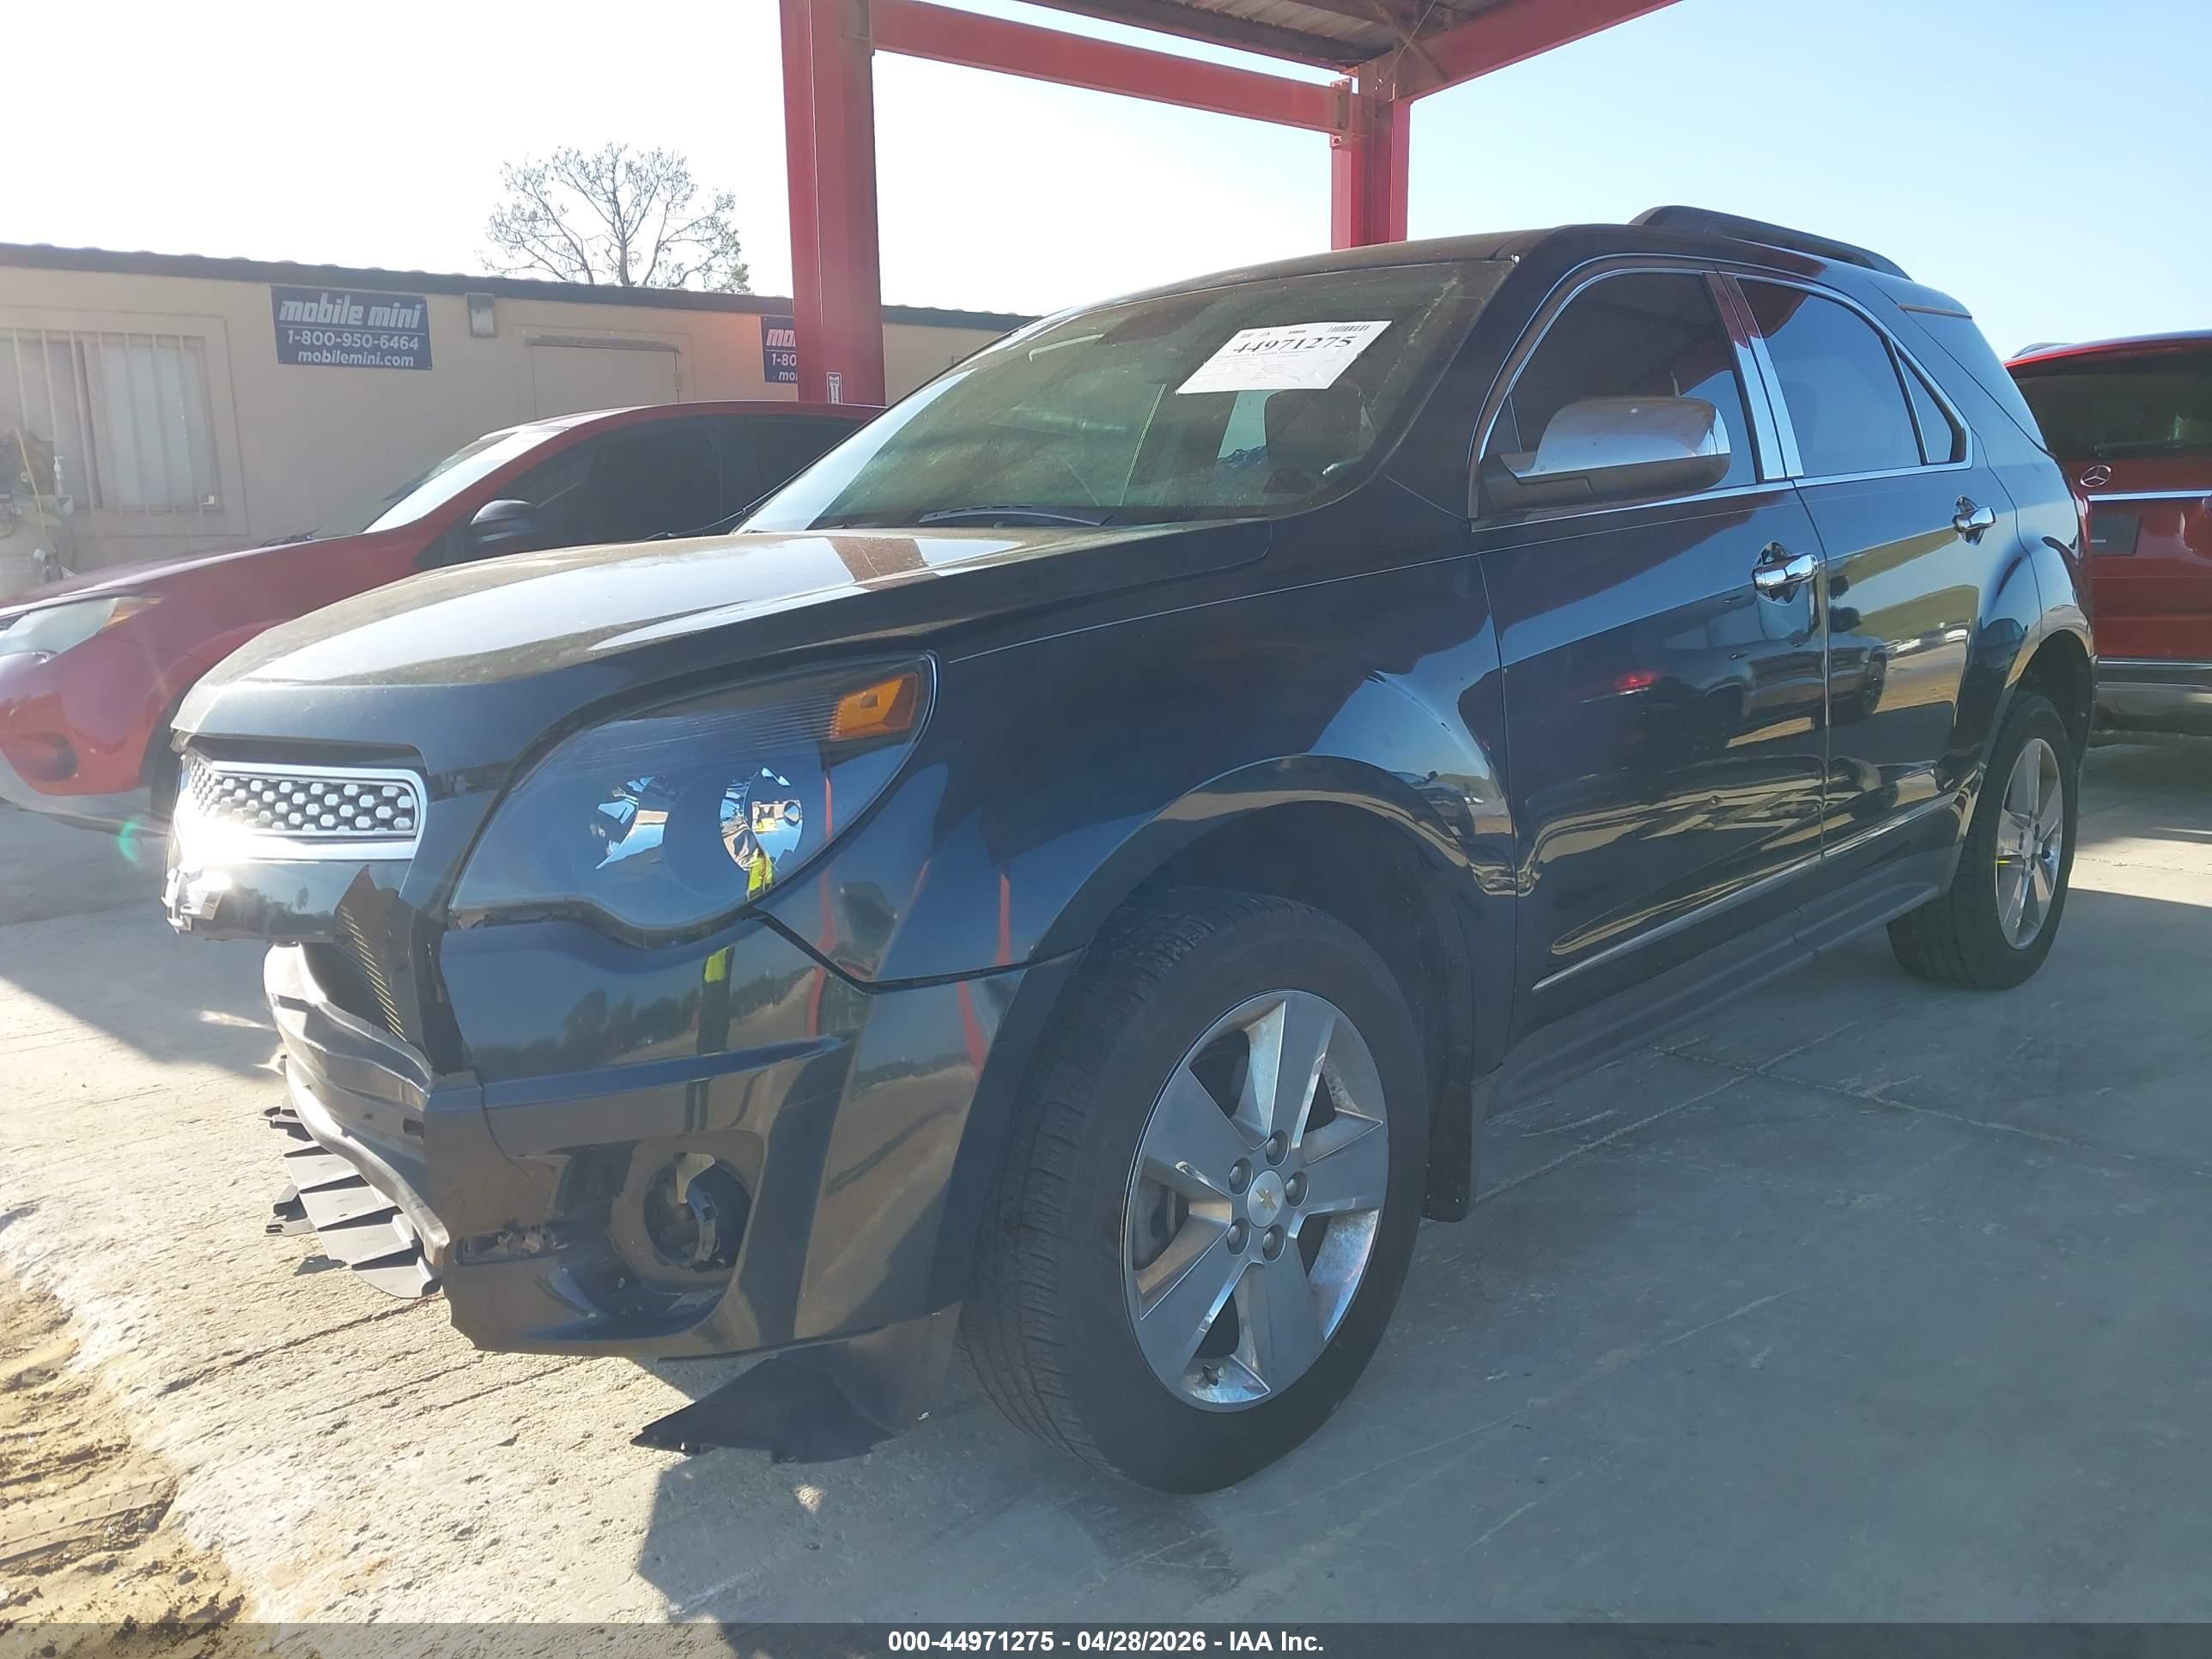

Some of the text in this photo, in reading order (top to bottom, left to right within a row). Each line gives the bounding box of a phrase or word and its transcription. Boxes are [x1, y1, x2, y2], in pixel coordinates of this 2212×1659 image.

[279, 292, 422, 329] mobile mini
[288, 329, 419, 351] 1-800-950-6464
[1233, 336, 1357, 353] 44971275
[297, 349, 414, 368] mobilemini.com
